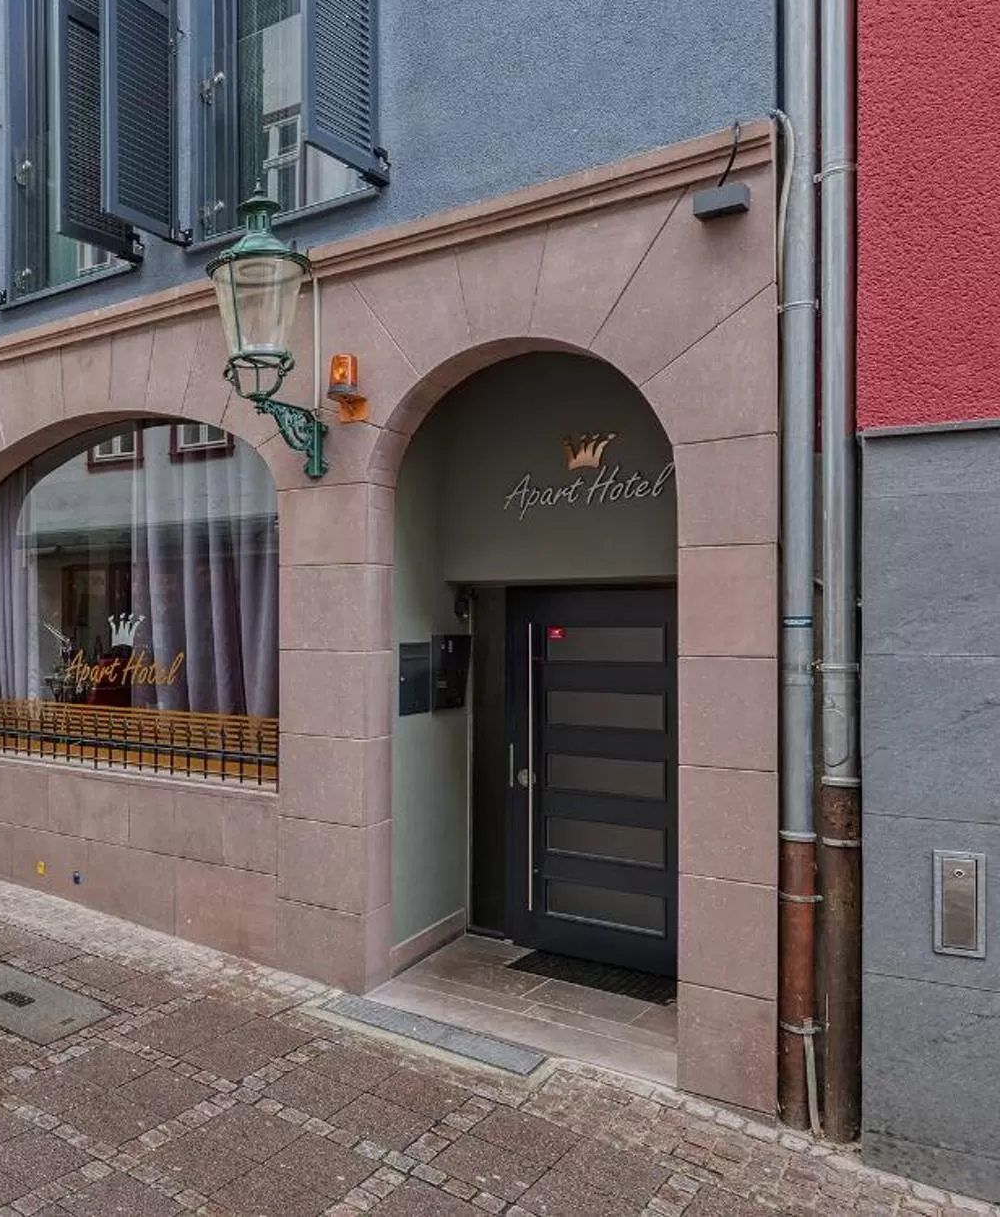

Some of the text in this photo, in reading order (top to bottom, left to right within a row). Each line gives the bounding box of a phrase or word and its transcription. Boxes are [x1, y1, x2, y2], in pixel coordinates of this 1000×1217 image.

[503, 464, 675, 521] Apart Hotel
[64, 648, 185, 694] Apart Hotel
